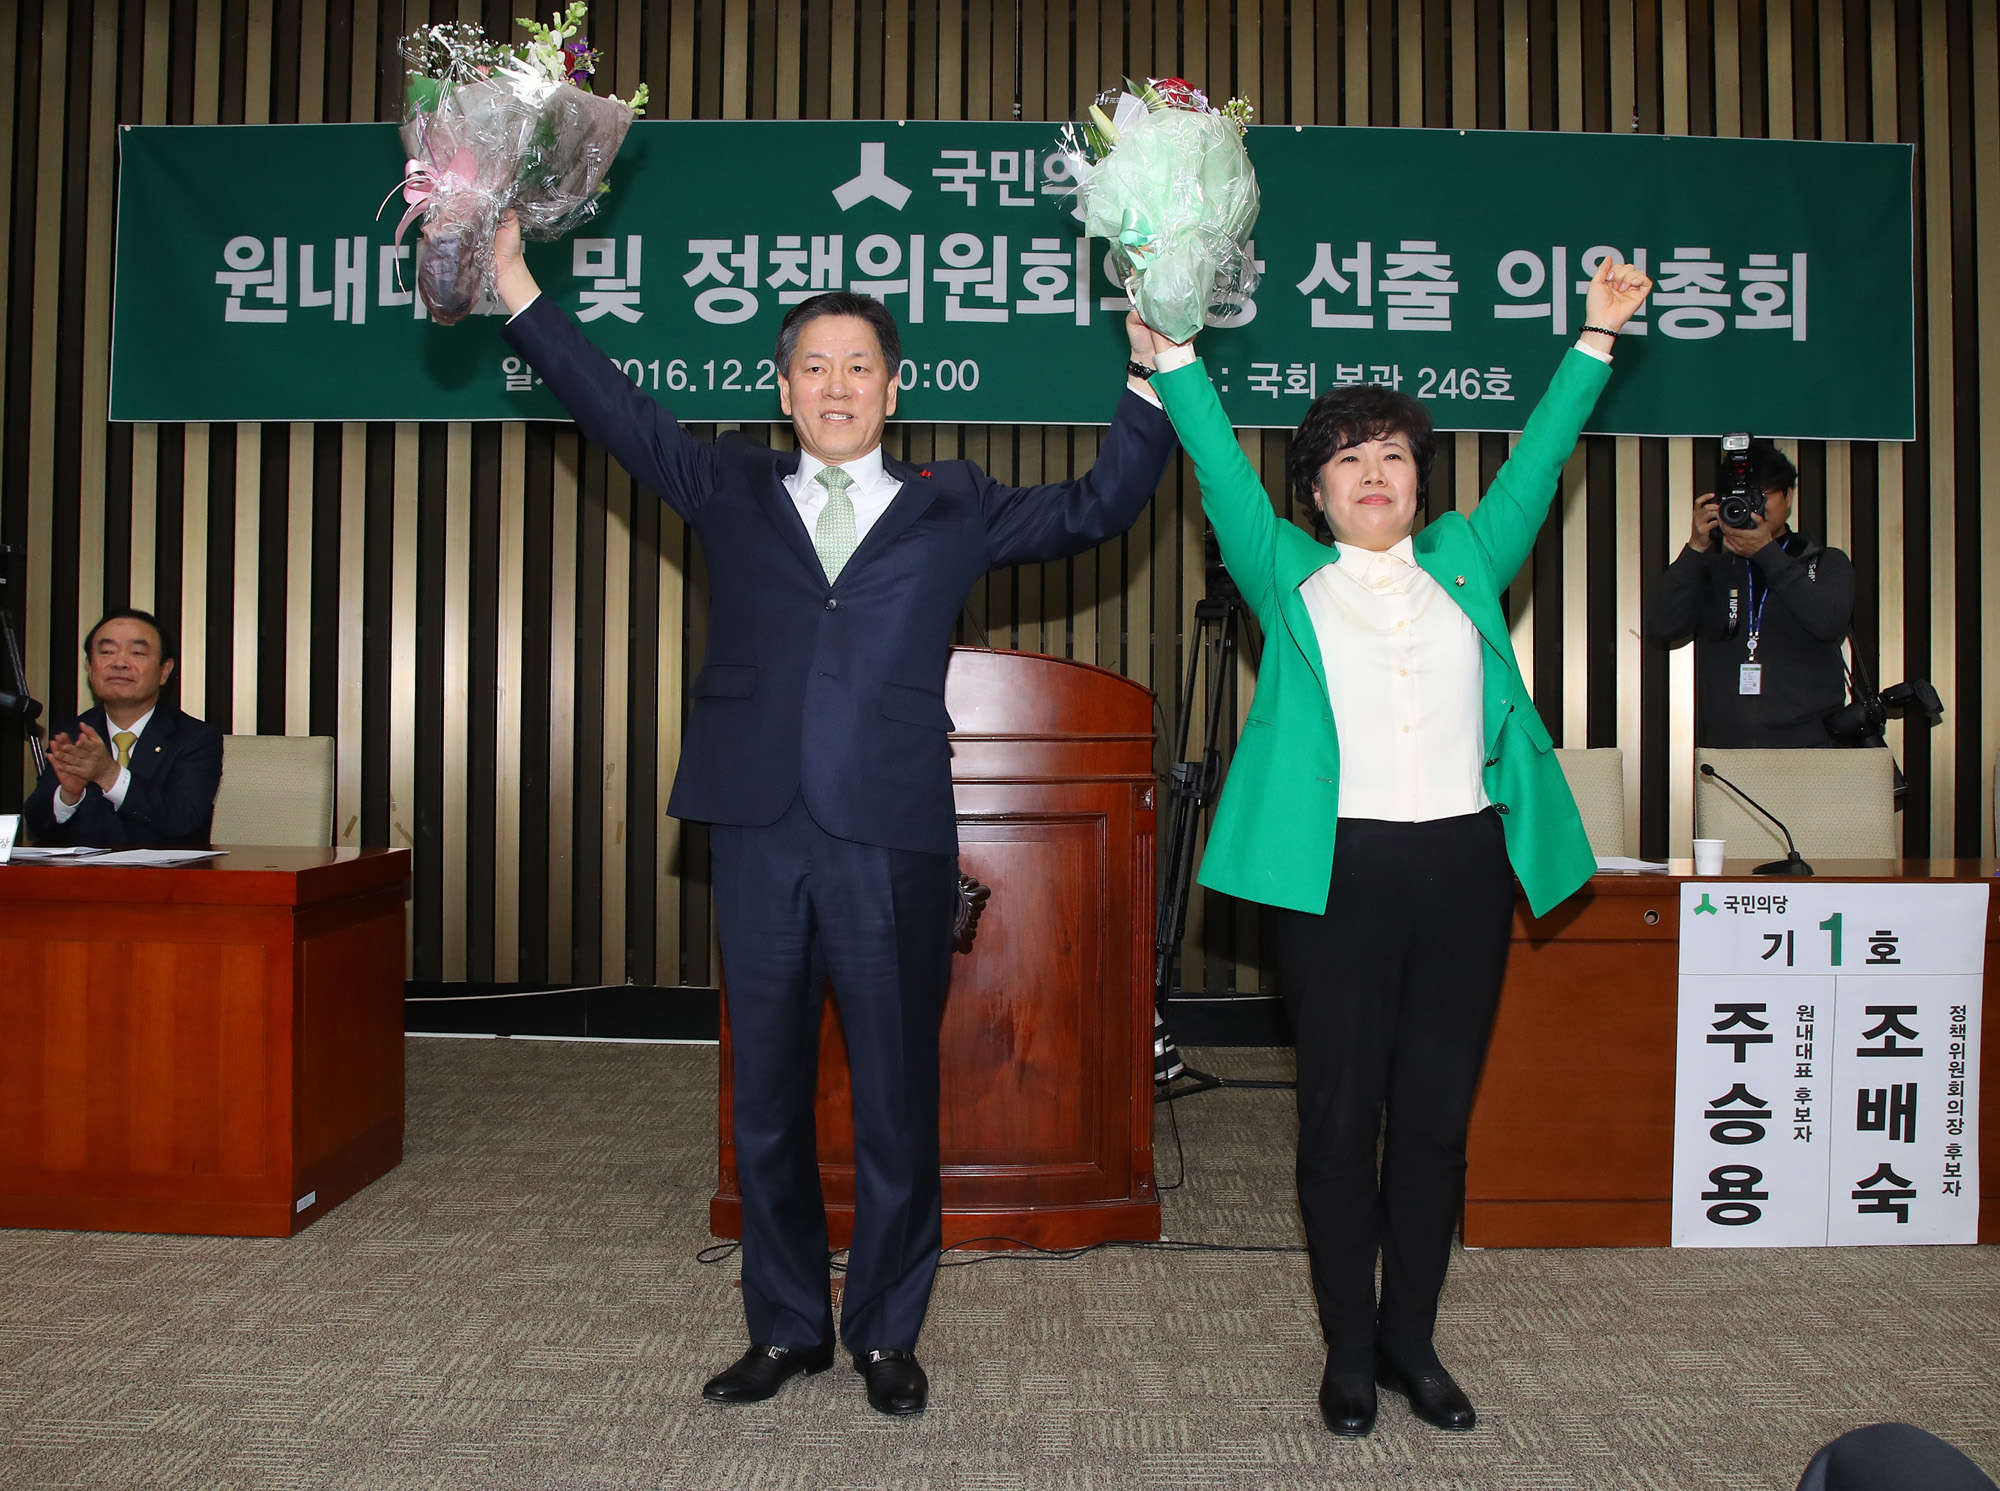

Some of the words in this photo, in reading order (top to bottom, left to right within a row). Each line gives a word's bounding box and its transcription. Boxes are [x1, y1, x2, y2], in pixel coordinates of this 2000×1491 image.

[932, 149, 1088, 222] 국민의
[572, 234, 645, 324] 및
[1296, 240, 1460, 332] 선출
[502, 356, 544, 391] 일
[610, 358, 780, 392] 016.12.2
[898, 359, 980, 392] 0:00
[1247, 362, 1316, 399] 국회
[1417, 366, 1516, 401] 246호
[1729, 598, 1738, 619] NPS
[1723, 895, 1789, 915] 국민의당
[1761, 930, 1795, 967] 기
[1819, 912, 1843, 967] 1
[1865, 930, 1902, 966] 호
[1793, 1004, 1815, 1079] 원내대표
[1945, 1004, 1968, 1136] 정책위원회의장
[1700, 1002, 1774, 1226] 주승용
[1792, 1086, 1814, 1143] 후보자
[1851, 1005, 1924, 1225] 조배숙
[1942, 1142, 1964, 1197] 후보자
